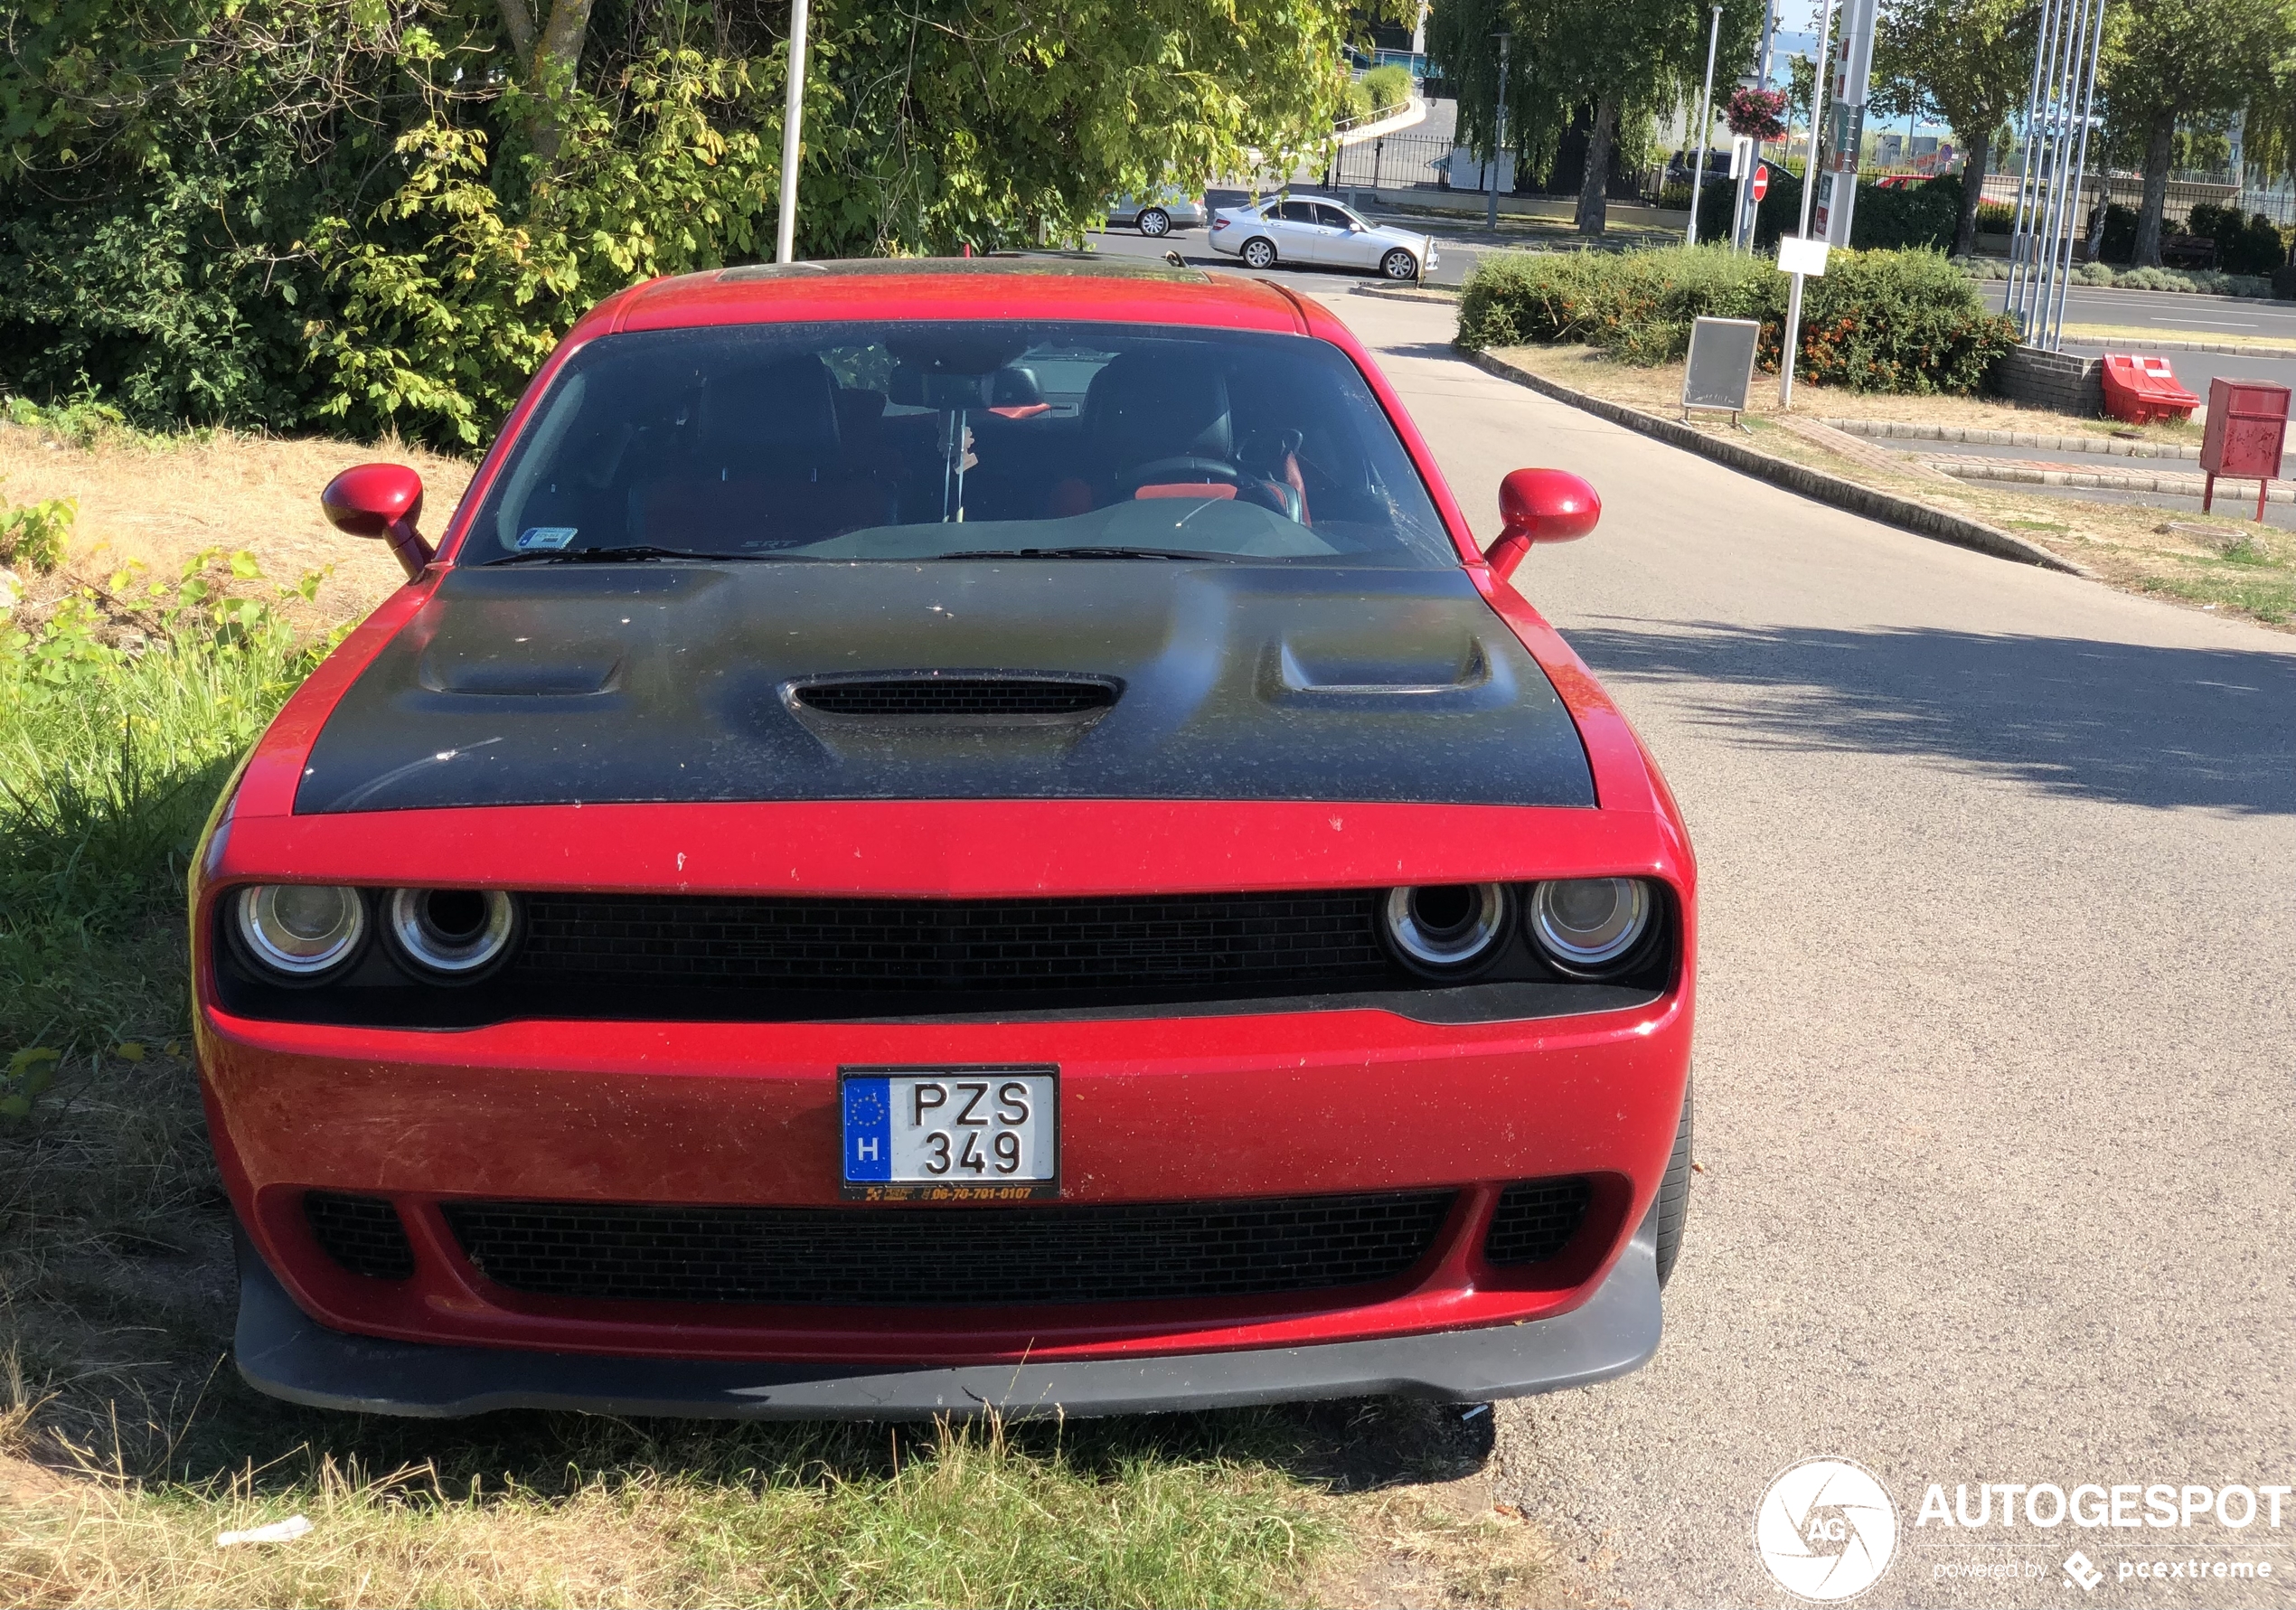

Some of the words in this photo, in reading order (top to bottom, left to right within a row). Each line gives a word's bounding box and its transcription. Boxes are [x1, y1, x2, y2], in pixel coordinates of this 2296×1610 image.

[914, 1081, 1031, 1126] PZS
[858, 1137, 878, 1162] H
[925, 1130, 1021, 1174] 349
[931, 1187, 1032, 1200] 06-70-701-0107
